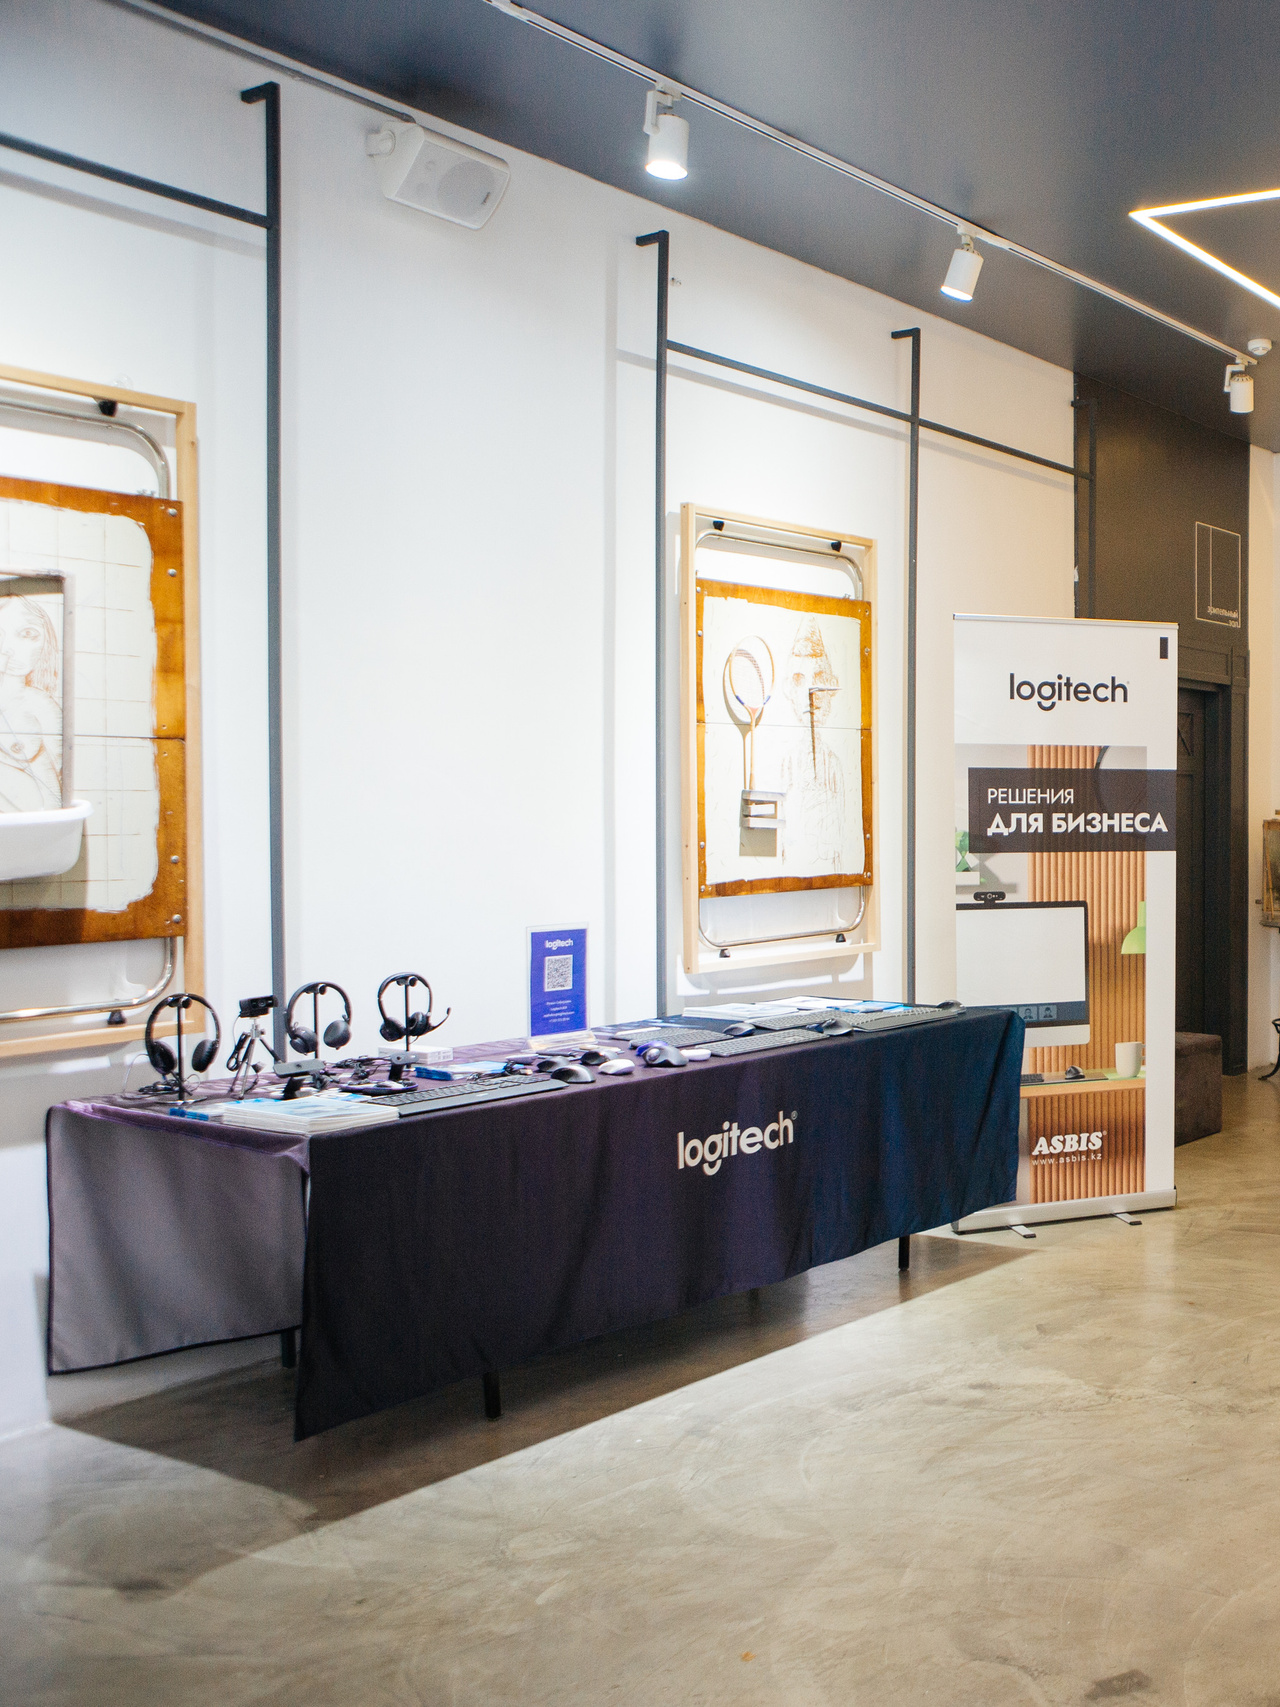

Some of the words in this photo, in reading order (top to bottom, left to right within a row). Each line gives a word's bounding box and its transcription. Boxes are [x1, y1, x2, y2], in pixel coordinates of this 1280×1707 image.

[1010, 673, 1128, 711] logitech
[987, 788, 1074, 804] РЕШЕНИЯ
[987, 812, 1044, 836] ДЛЯ
[1052, 812, 1168, 833] БИЗНЕСА
[545, 938, 573, 950] logitech
[677, 1110, 794, 1176] logitech
[1032, 1152, 1102, 1166] www.asbis.kz
